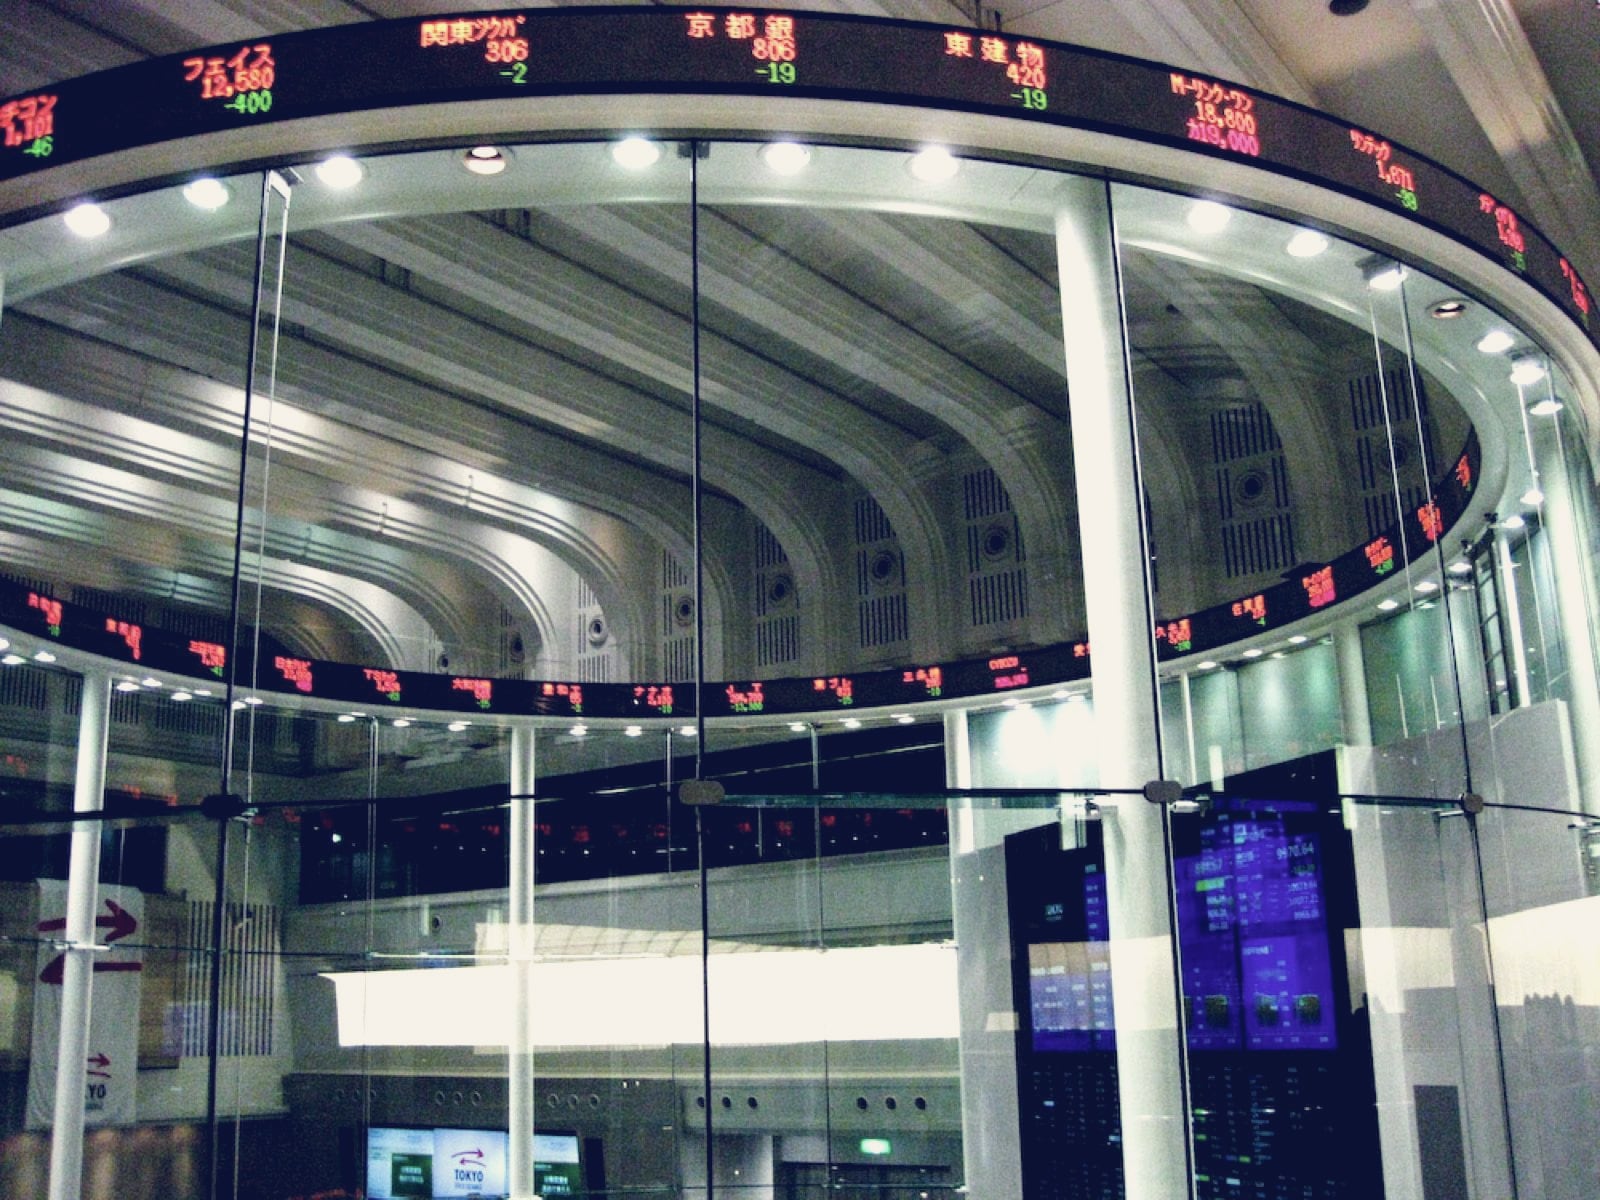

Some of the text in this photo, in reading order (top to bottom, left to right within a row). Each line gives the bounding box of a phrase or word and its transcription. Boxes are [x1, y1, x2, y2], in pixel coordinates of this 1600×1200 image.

[684, 12, 795, 40] 京都銀
[484, 39, 529, 63] 306
[751, 38, 796, 61] 806
[183, 44, 275, 82] フェイス
[499, 63, 529, 84] -2
[753, 62, 797, 84] -19
[1006, 63, 1046, 89] 420
[223, 89, 273, 114] -400
[1010, 87, 1048, 110] -19
[454, 1168, 484, 1182] TOKYO
